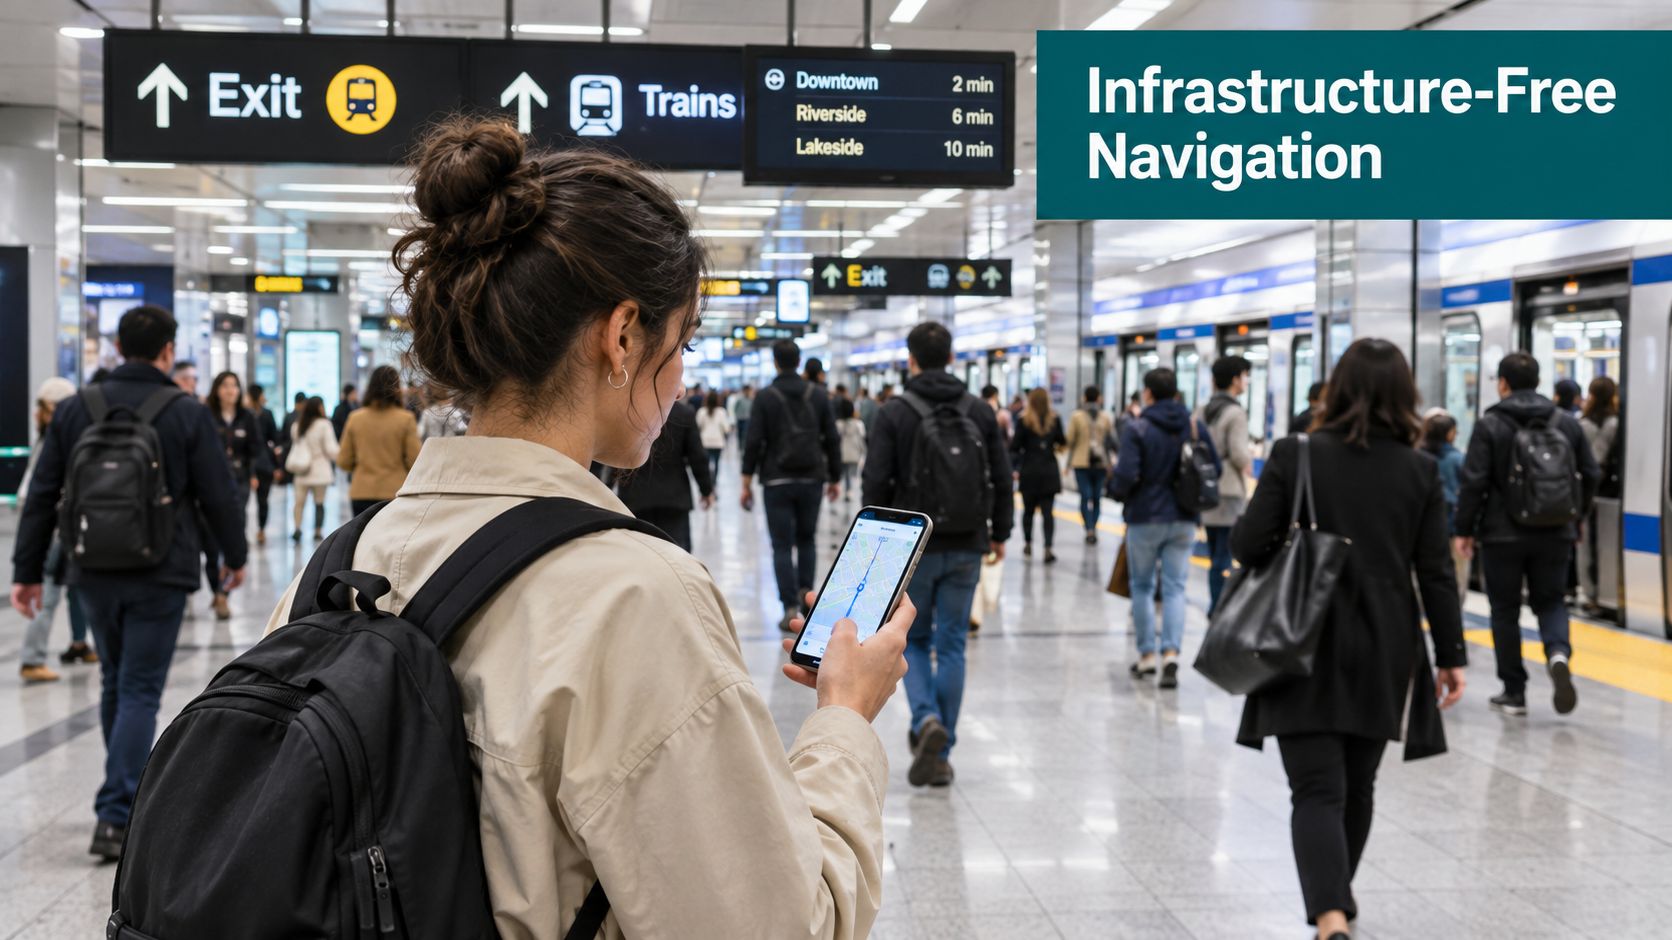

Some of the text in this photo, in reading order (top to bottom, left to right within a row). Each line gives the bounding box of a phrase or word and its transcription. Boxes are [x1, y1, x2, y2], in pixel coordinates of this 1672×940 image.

[796, 70, 994, 93] Downtown 2 min
[208, 72, 302, 119] Exit
[638, 83, 738, 119] Trains
[796, 103, 994, 126] Riverside 6 min
[796, 137, 994, 158] Lakeside 10 min
[846, 263, 888, 288] Exit
